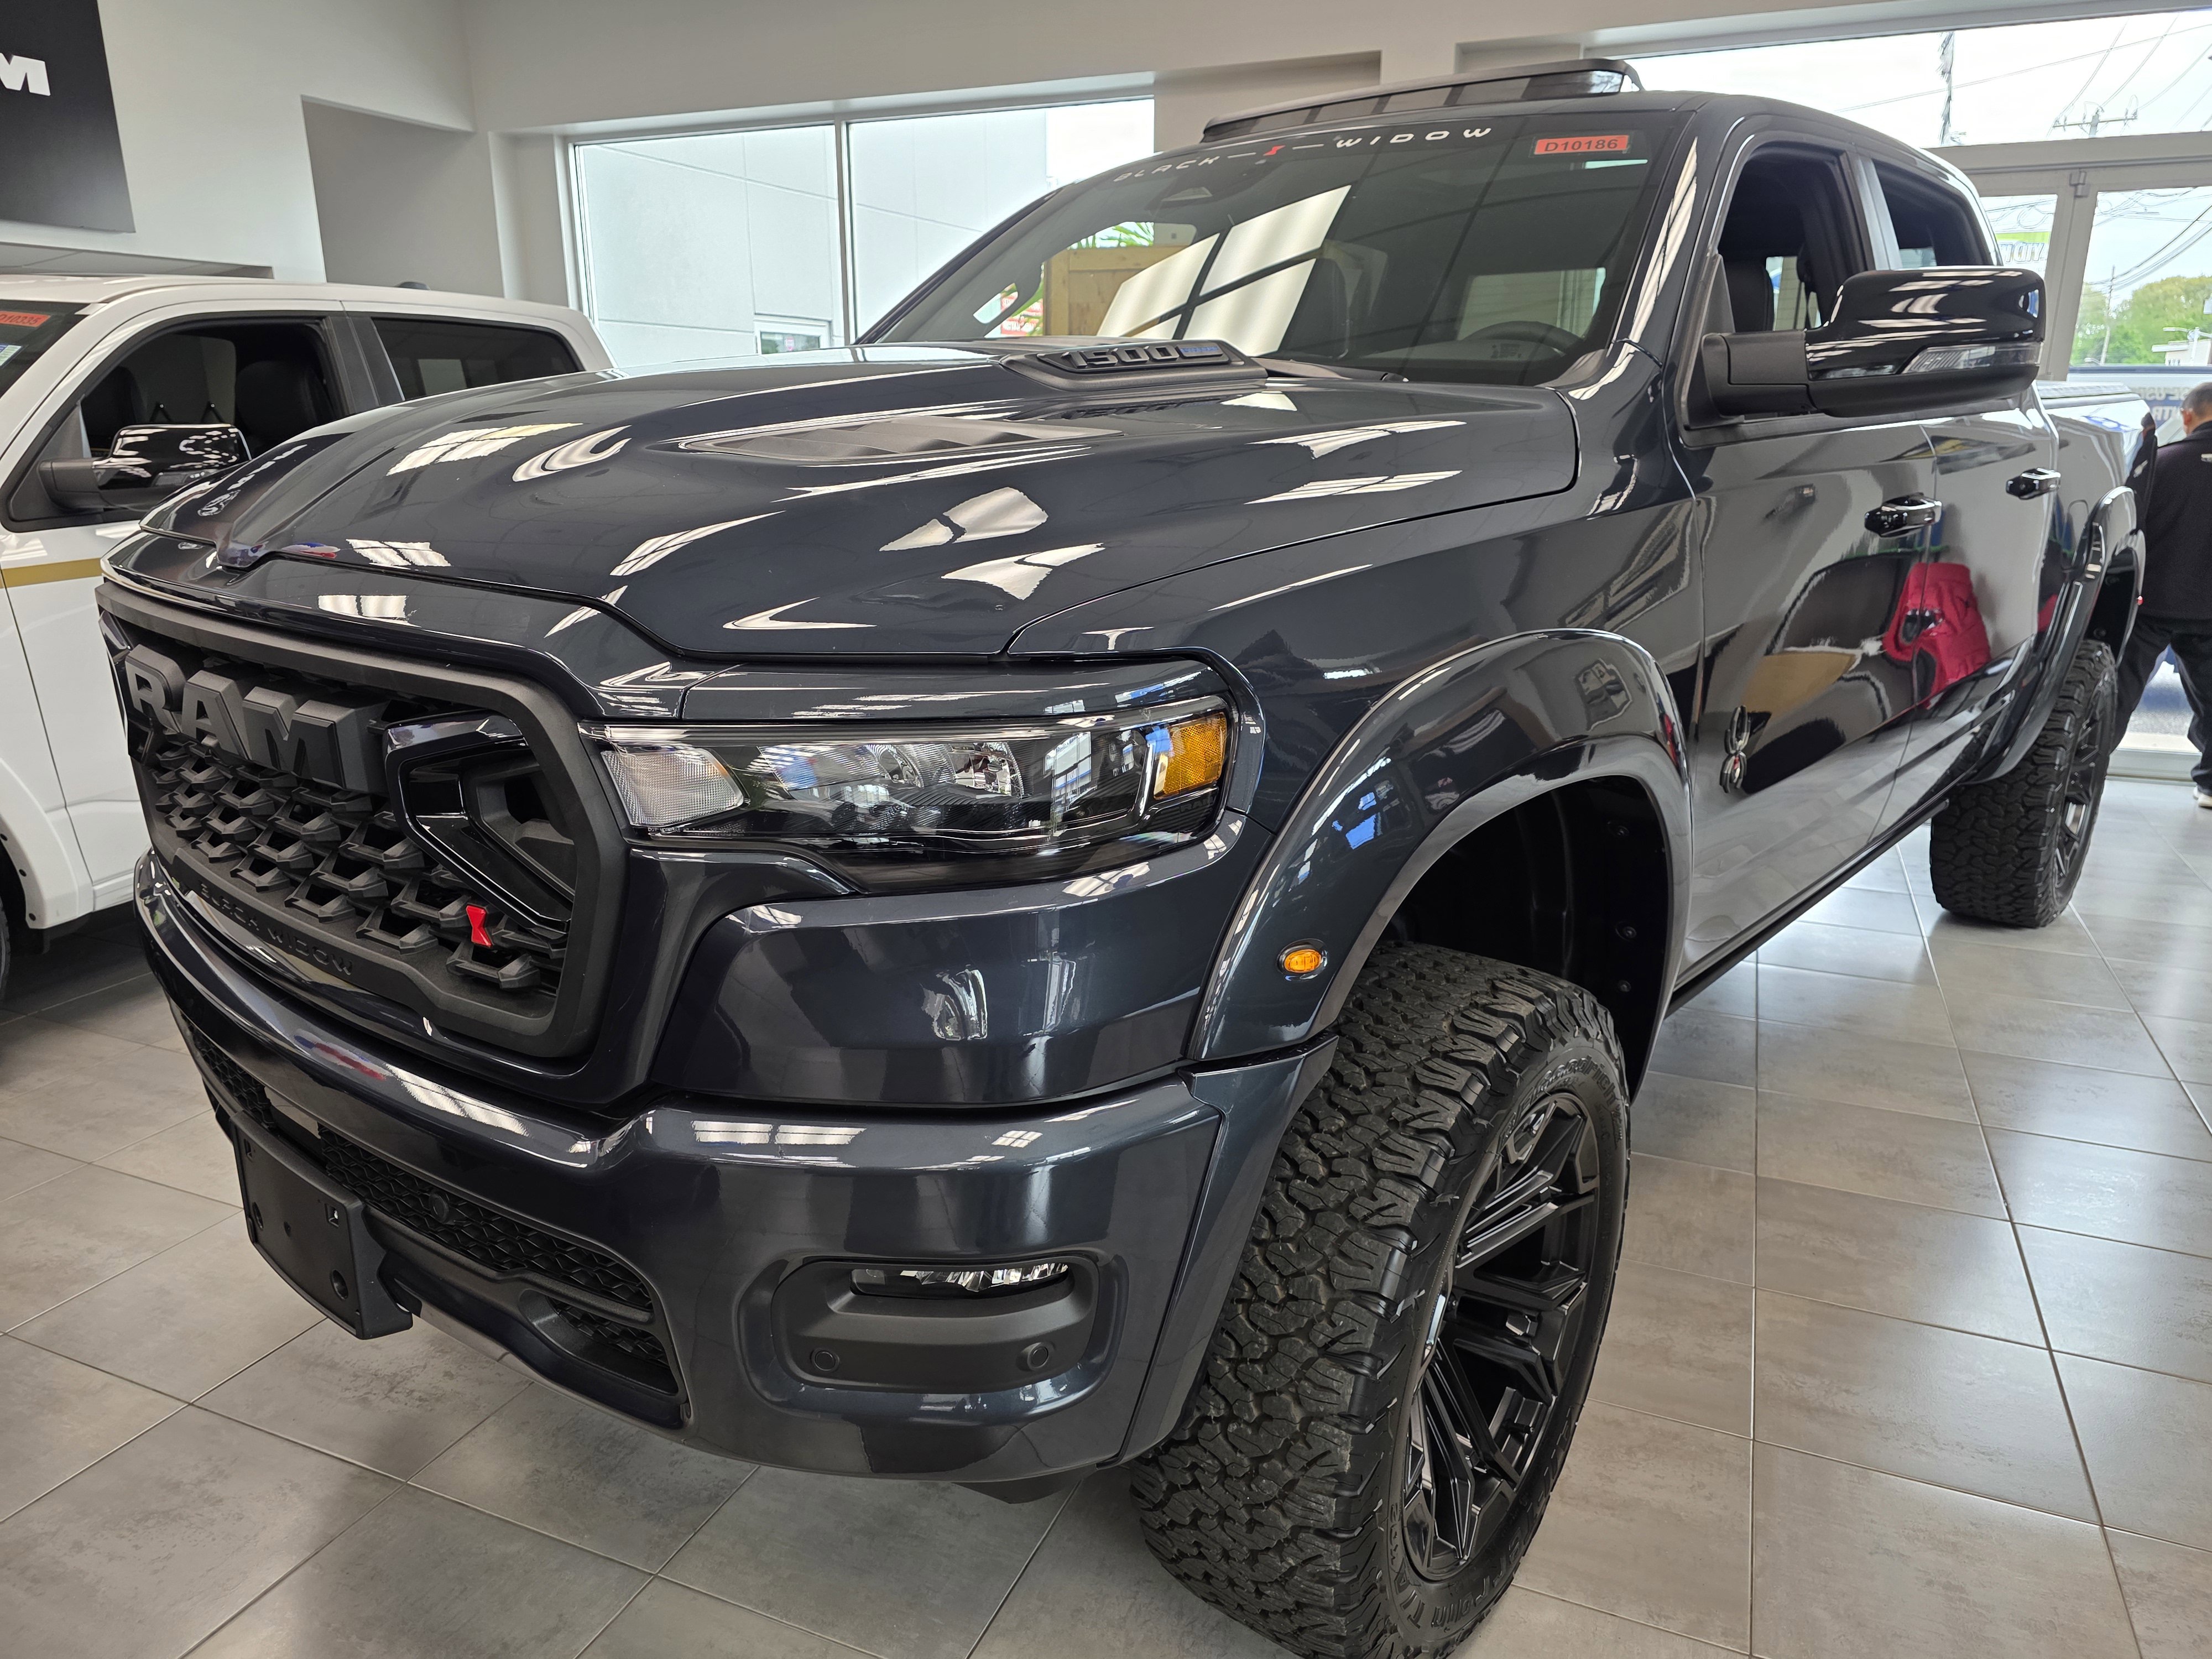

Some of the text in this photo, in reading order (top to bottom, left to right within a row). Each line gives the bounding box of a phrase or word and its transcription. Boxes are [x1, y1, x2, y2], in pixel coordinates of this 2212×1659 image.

[1113, 127, 1491, 182] BLACK WIDOW
[1544, 138, 1619, 153] D10186
[1061, 345, 1180, 369] 1500
[125, 644, 357, 791] RAM
[267, 927, 352, 975] WIDOW
